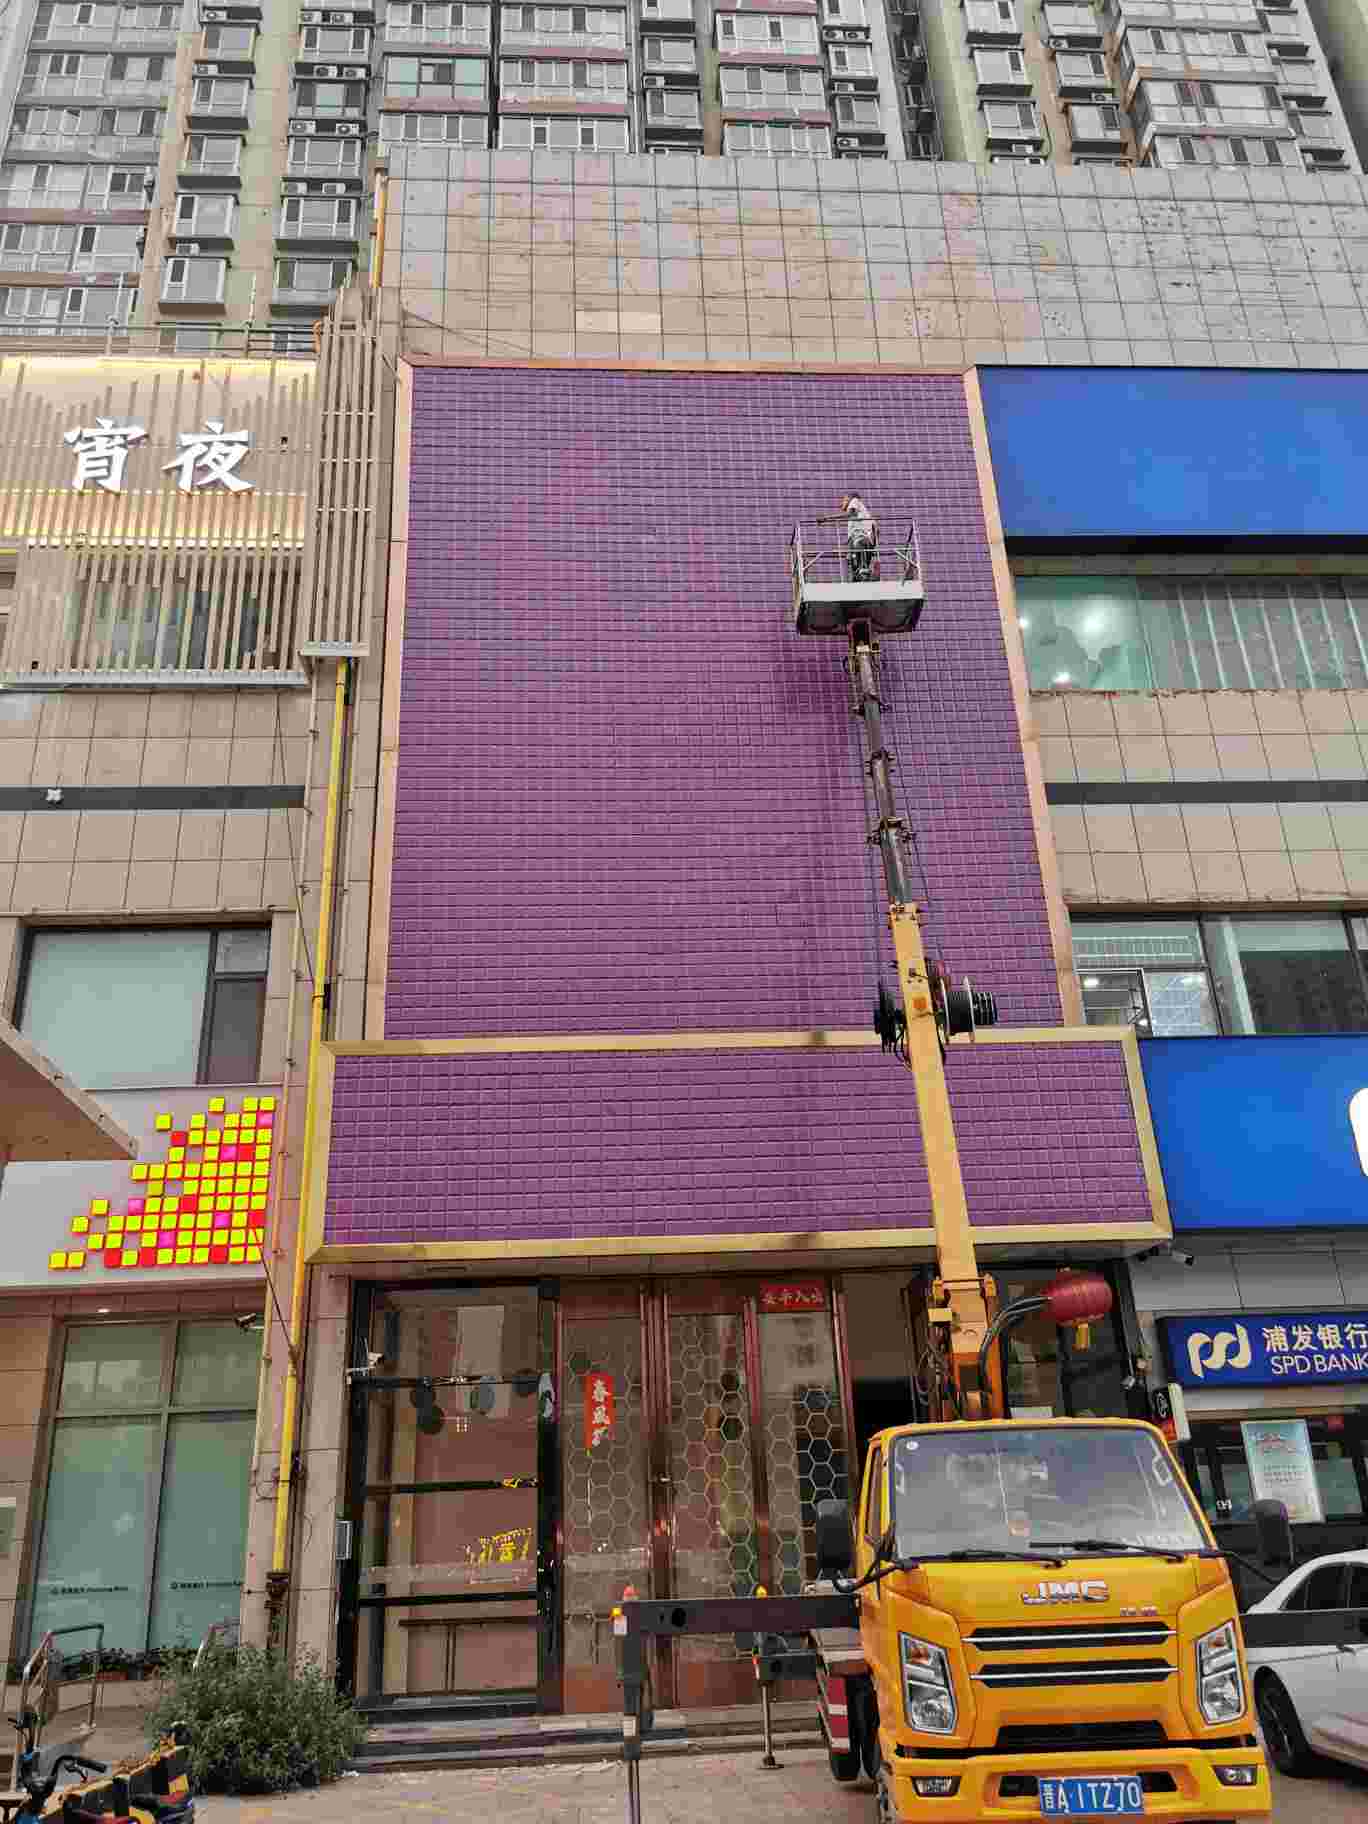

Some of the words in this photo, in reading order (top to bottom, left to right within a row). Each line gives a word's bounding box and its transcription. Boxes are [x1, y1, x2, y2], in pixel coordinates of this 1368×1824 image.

[64, 417, 255, 493] 宵夜
[1262, 1322, 1368, 1353] 浦发银行
[1270, 1355, 1311, 1374] SPD
[1313, 1353, 1368, 1373] BANK
[1020, 1580, 1109, 1605] JMC
